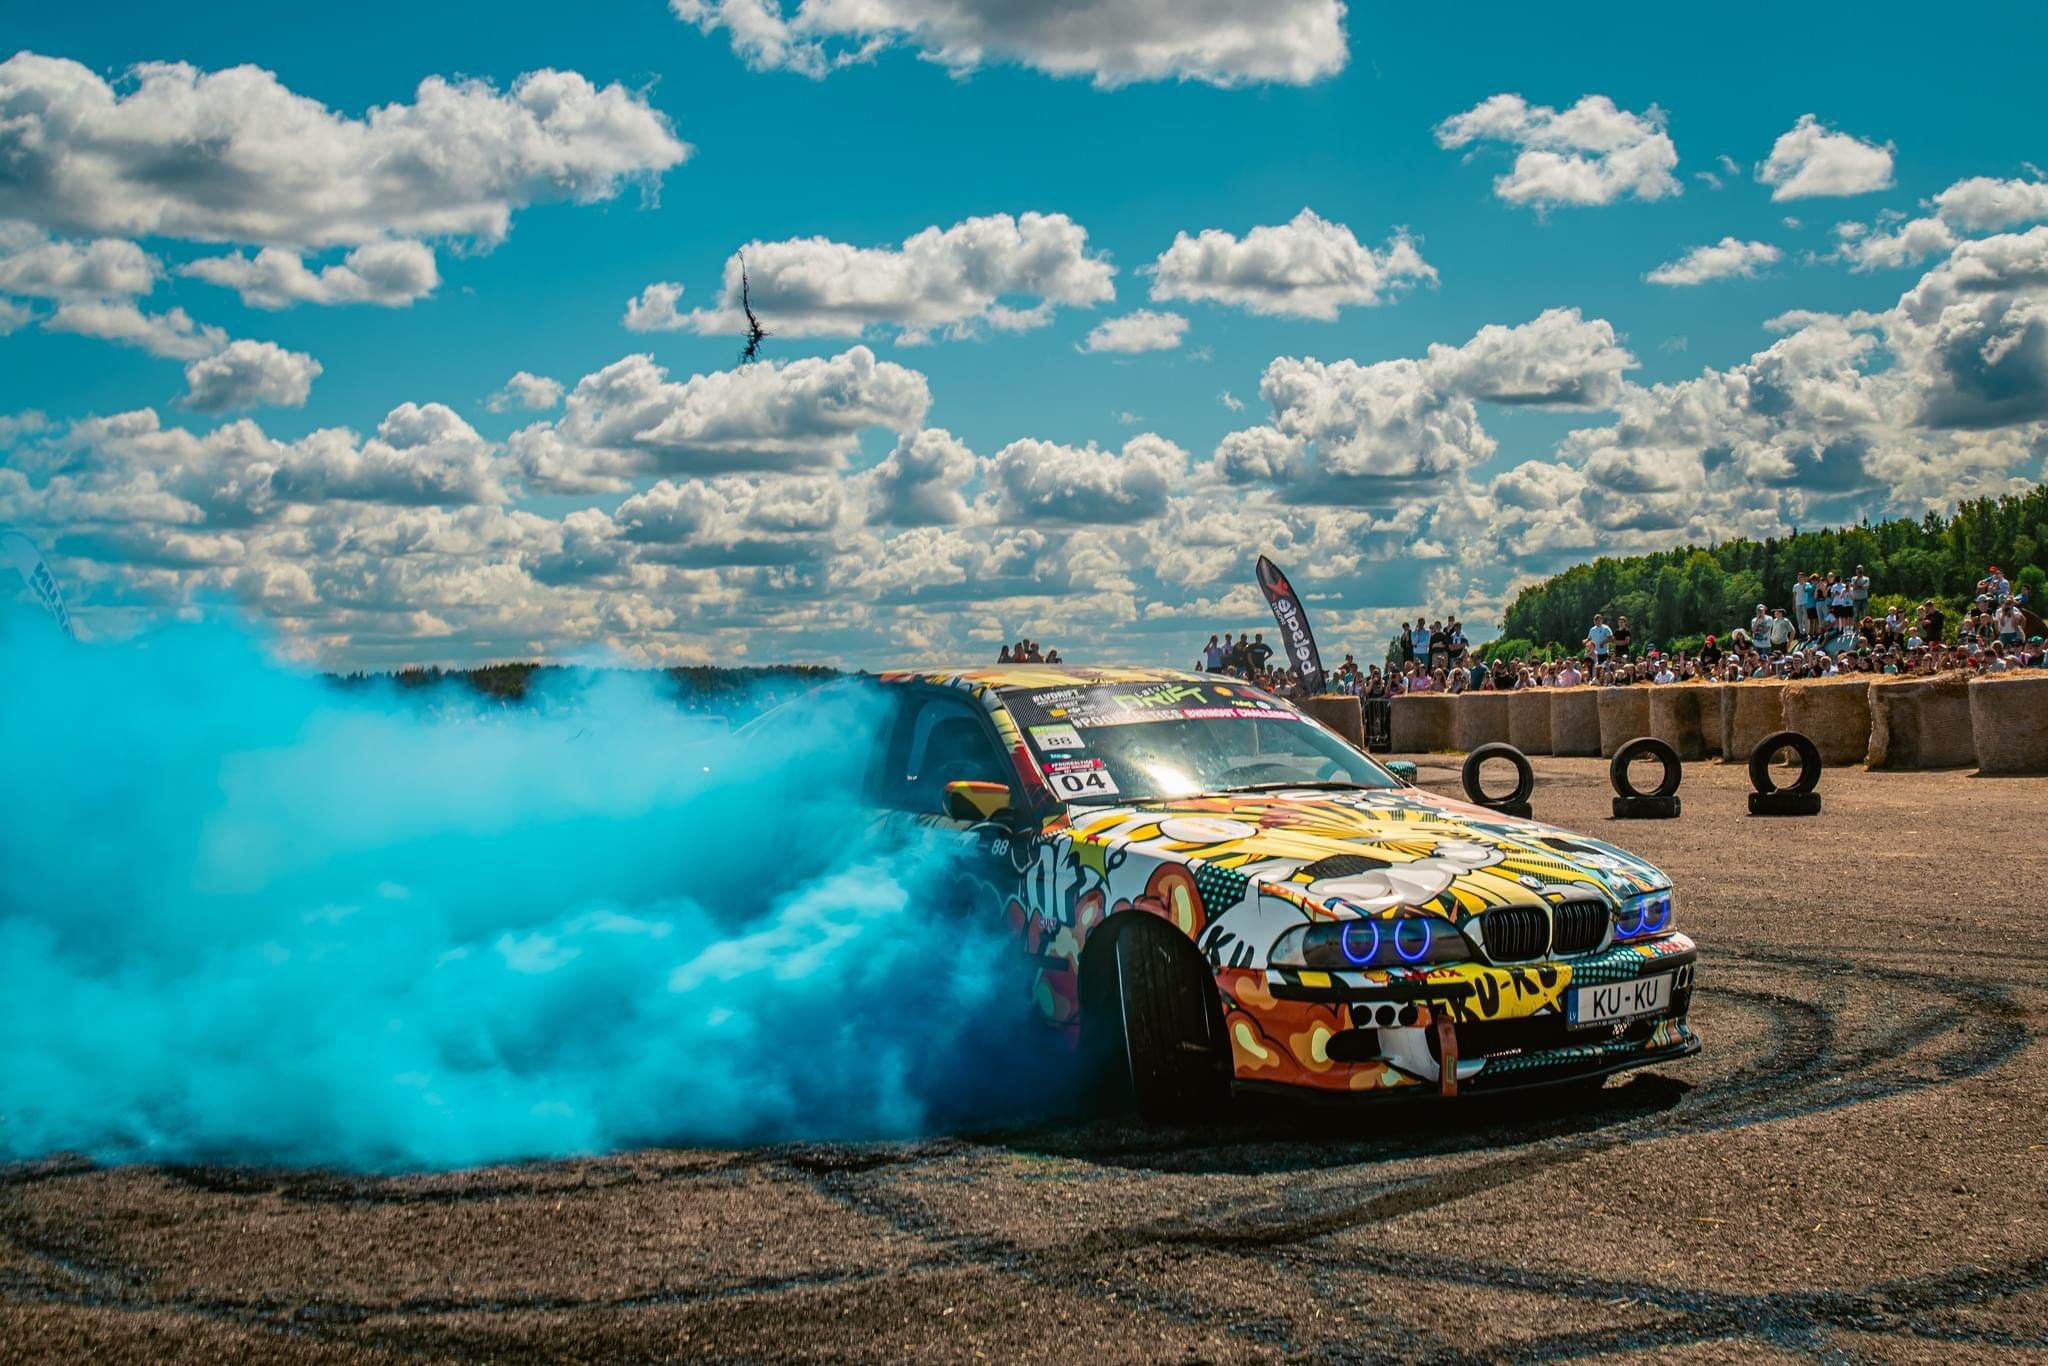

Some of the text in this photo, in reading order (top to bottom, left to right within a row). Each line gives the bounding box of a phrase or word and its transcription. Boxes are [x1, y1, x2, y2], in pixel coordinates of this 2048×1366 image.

[1111, 685, 1208, 711] DRIFT
[1047, 737, 1073, 746] 88
[1061, 773, 1106, 792] 04
[991, 838, 1009, 856] 88
[1593, 979, 1658, 1018] KU-KU
[1569, 1011, 1577, 1022] LV
